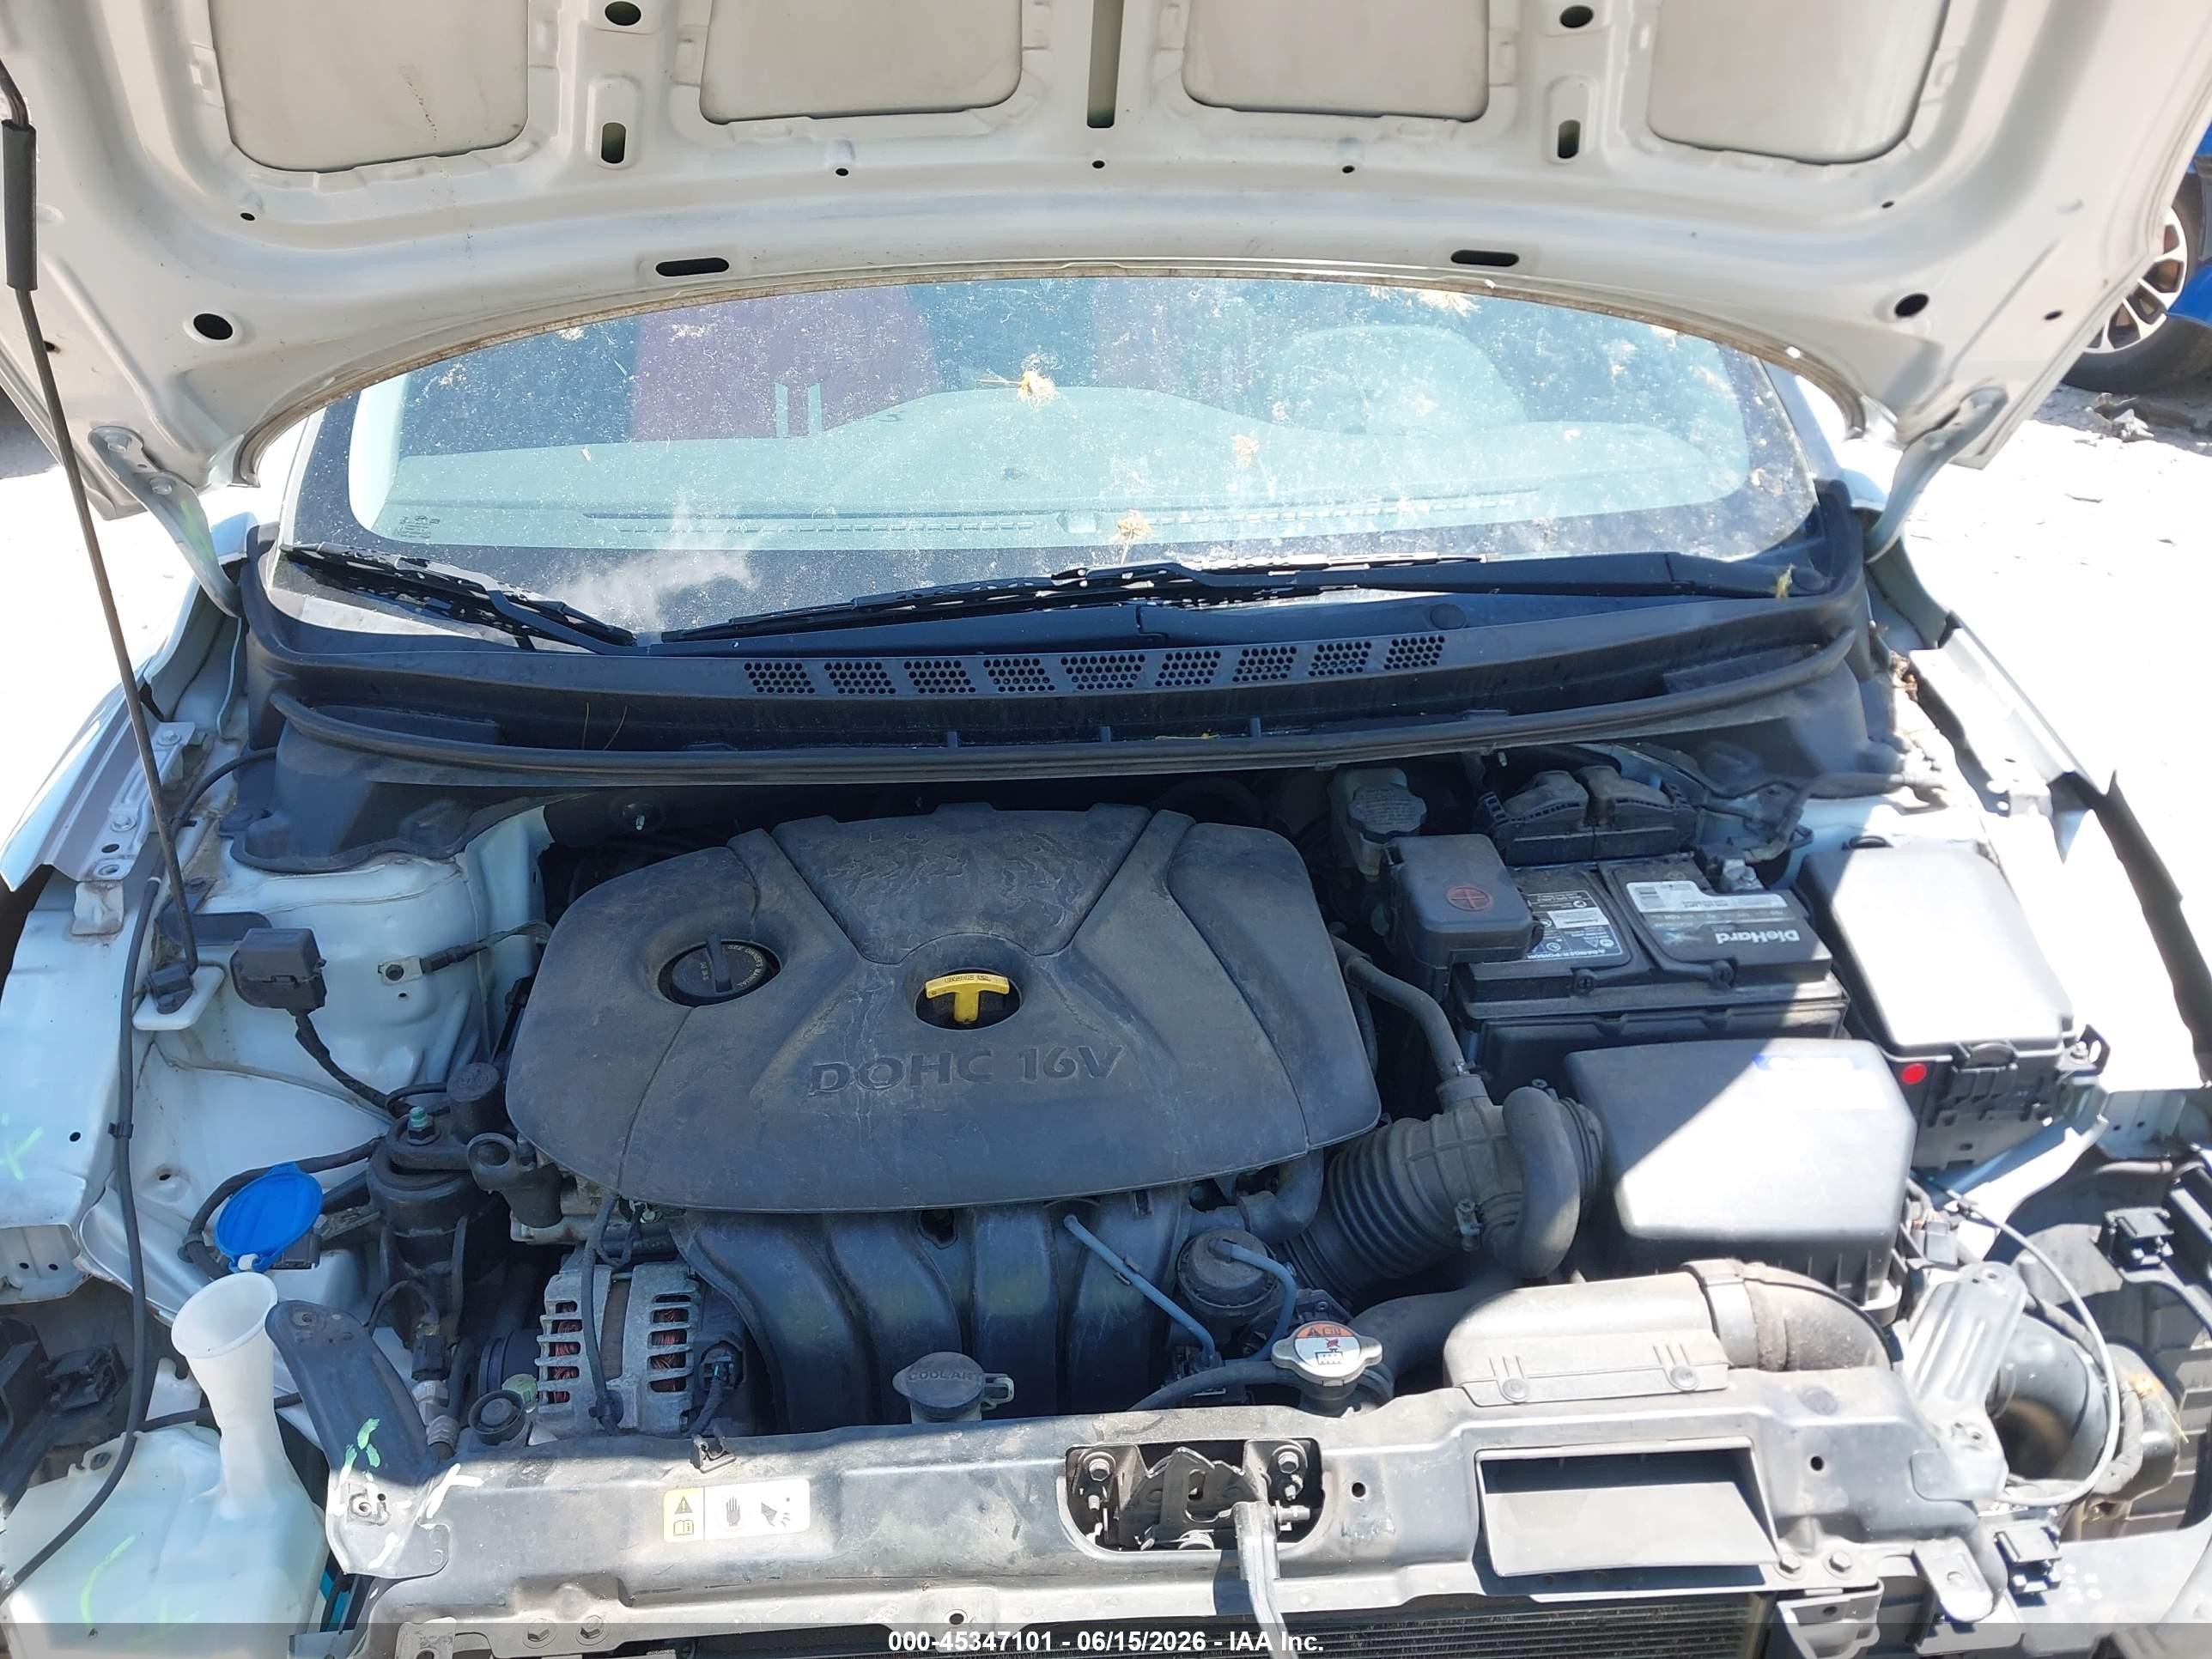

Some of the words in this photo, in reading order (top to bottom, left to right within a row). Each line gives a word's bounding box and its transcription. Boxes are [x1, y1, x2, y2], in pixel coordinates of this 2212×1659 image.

[1715, 929, 1801, 945] DieHard
[808, 1048, 994, 1097] DOHC
[1018, 1044, 1124, 1084] 16V
